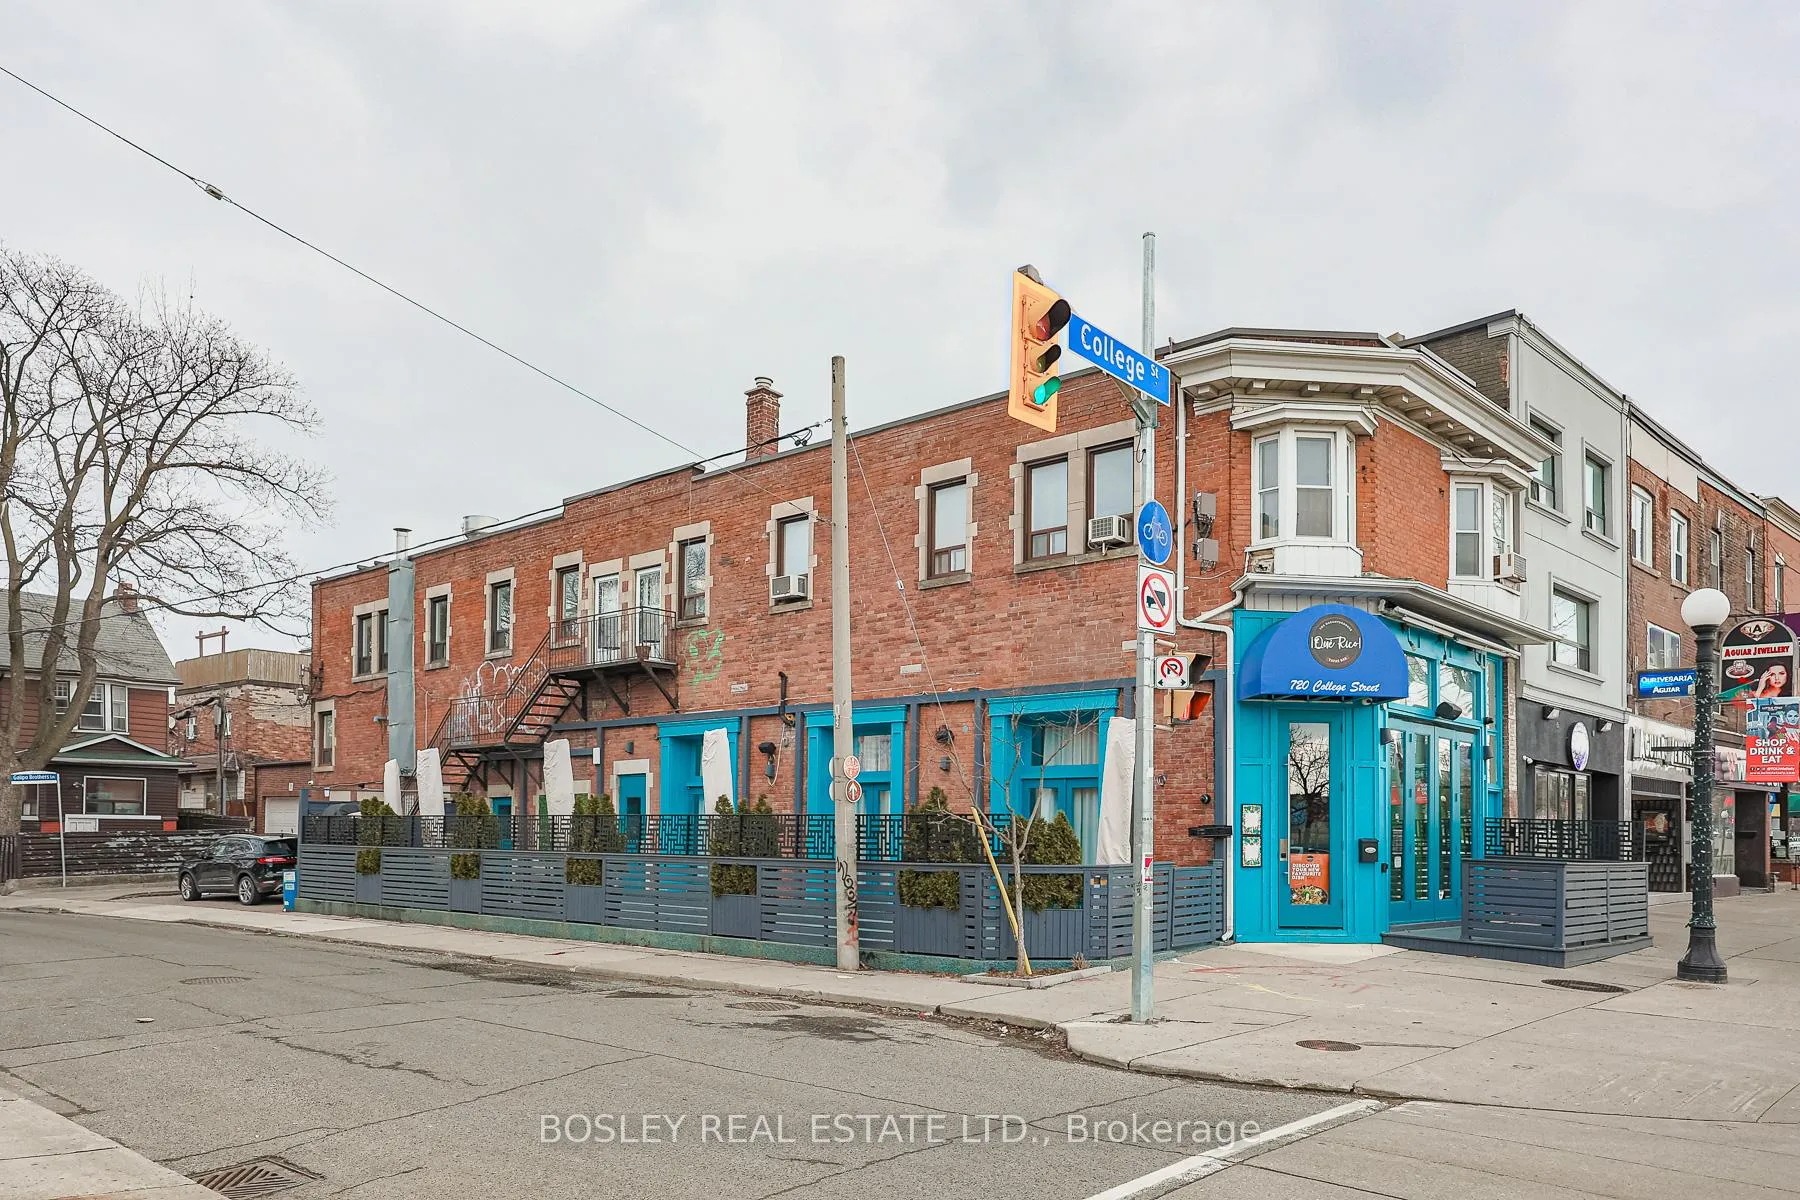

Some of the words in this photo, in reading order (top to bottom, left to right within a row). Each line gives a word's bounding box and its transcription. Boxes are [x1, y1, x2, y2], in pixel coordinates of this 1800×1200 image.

[1081, 324, 1145, 383] College
[1151, 364, 1159, 379] St
[1724, 648, 1752, 658] AGUIAR
[1753, 645, 1790, 656] JEWELLERY
[1290, 679, 1310, 691] 720
[1312, 679, 1347, 695] College
[1349, 681, 1380, 693] Street
[1652, 685, 1681, 694] AGUIAR
[1749, 747, 1784, 756] DRINK
[1786, 746, 1795, 755] &
[1761, 755, 1782, 764] EAT
